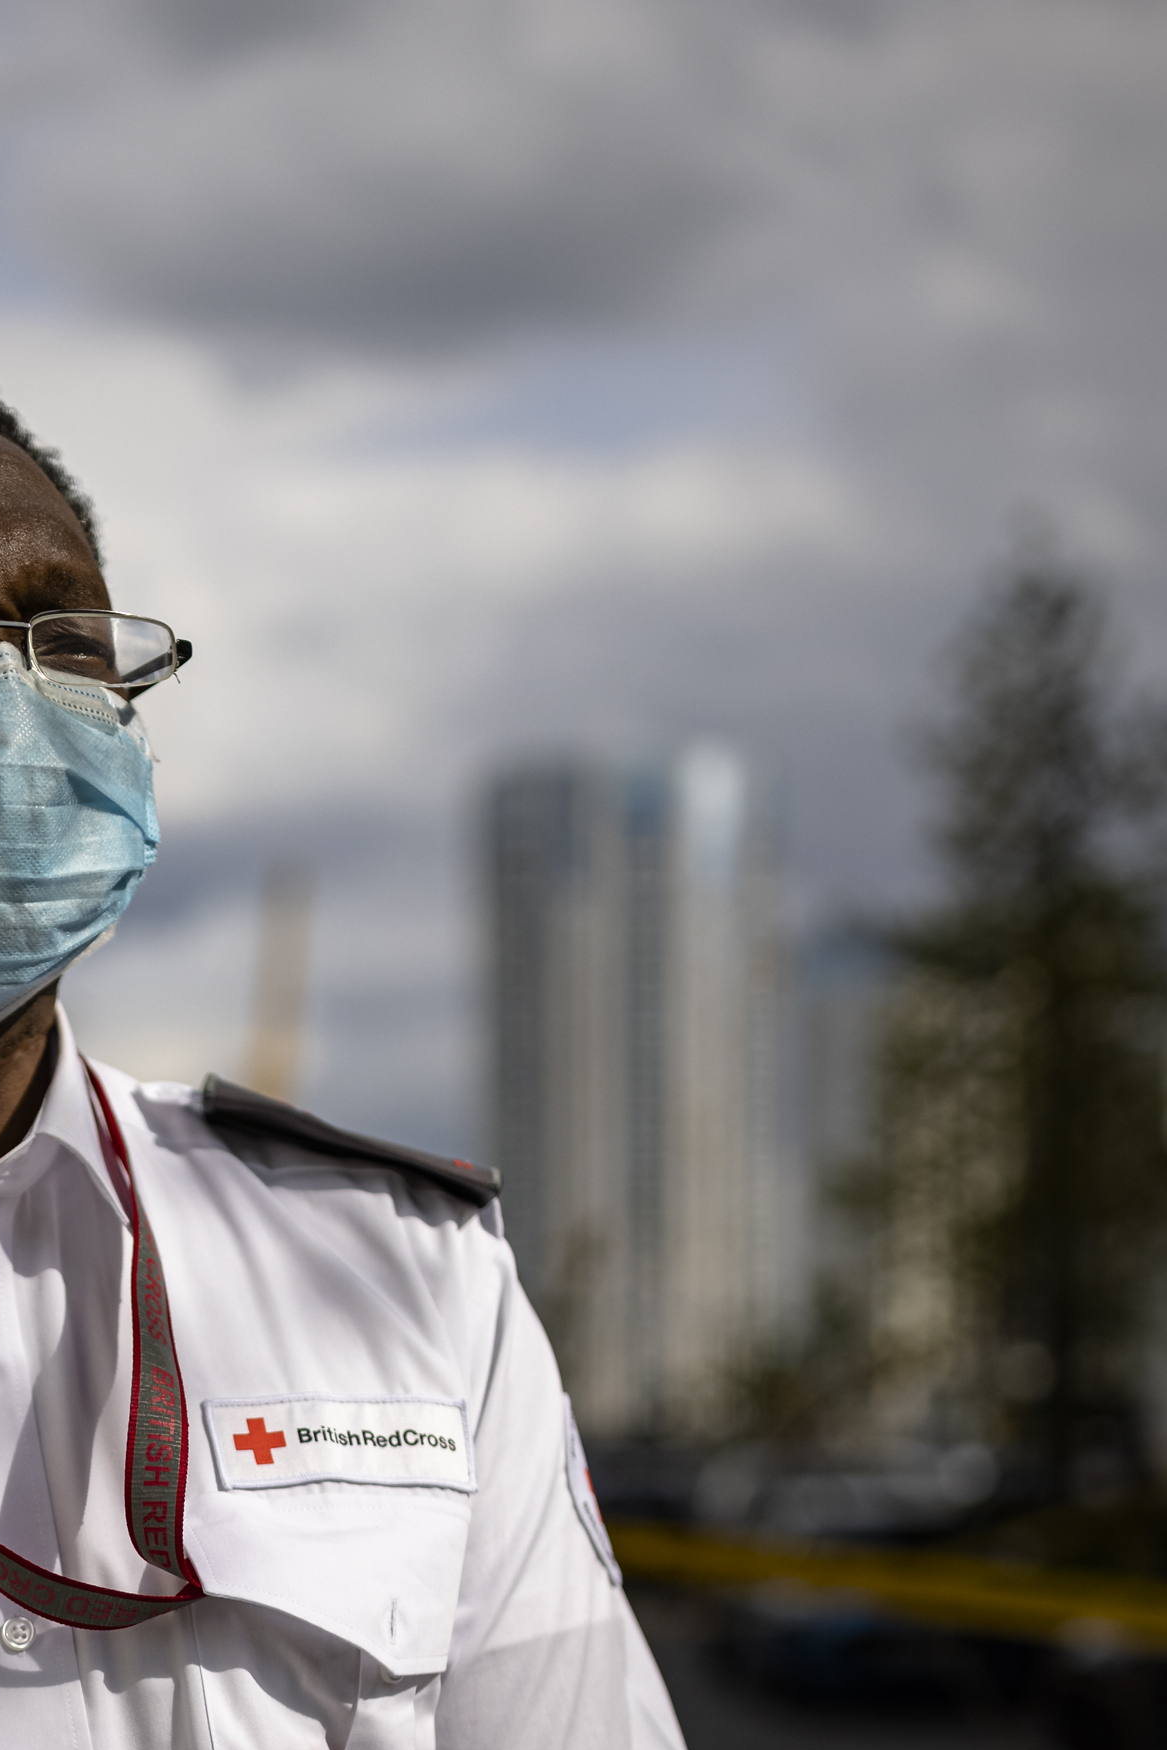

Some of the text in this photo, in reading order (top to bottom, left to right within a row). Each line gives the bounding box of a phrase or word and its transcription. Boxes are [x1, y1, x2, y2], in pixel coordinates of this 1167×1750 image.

[144, 1257, 167, 1345] CROSS
[143, 1366, 176, 1487] BRITISH
[297, 1425, 457, 1452] BritishRedCross
[142, 1500, 172, 1570] RED
[65, 1595, 139, 1625] RED
